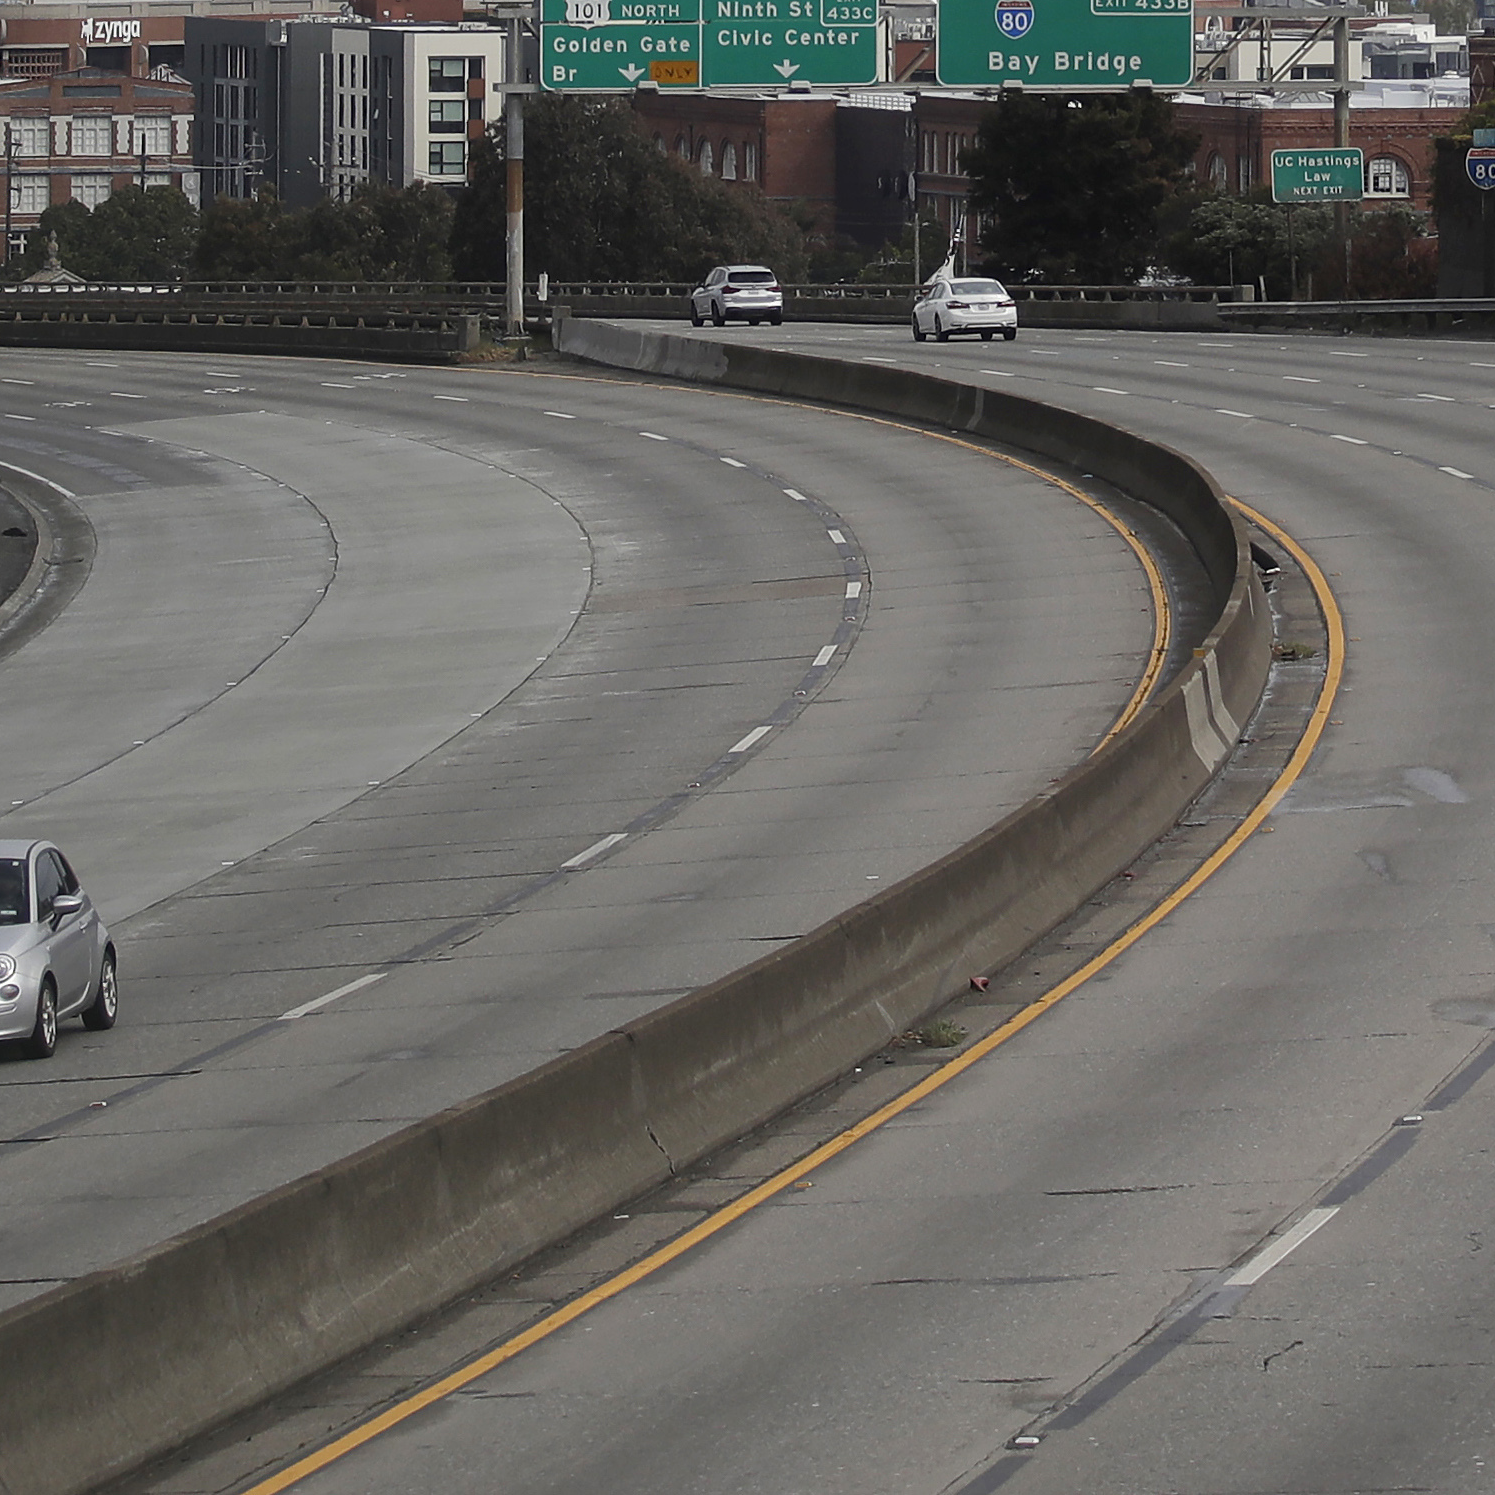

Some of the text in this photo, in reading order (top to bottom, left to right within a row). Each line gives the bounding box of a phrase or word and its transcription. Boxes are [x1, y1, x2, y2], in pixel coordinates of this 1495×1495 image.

[574, 3, 680, 19] 101 NORTH
[718, 1, 813, 17] Ninth St
[827, 7, 873, 19] 433C
[1002, 12, 1028, 31] 80
[94, 20, 141, 43] zynga
[718, 29, 860, 46] Civic Center
[553, 36, 691, 53] Golden Gate
[988, 51, 1142, 76] Bay Bridge
[553, 65, 577, 81] Br
[1275, 155, 1360, 169] UC Hastings
[1304, 171, 1331, 182] Law
[1293, 186, 1343, 195] NEXT EXIT
